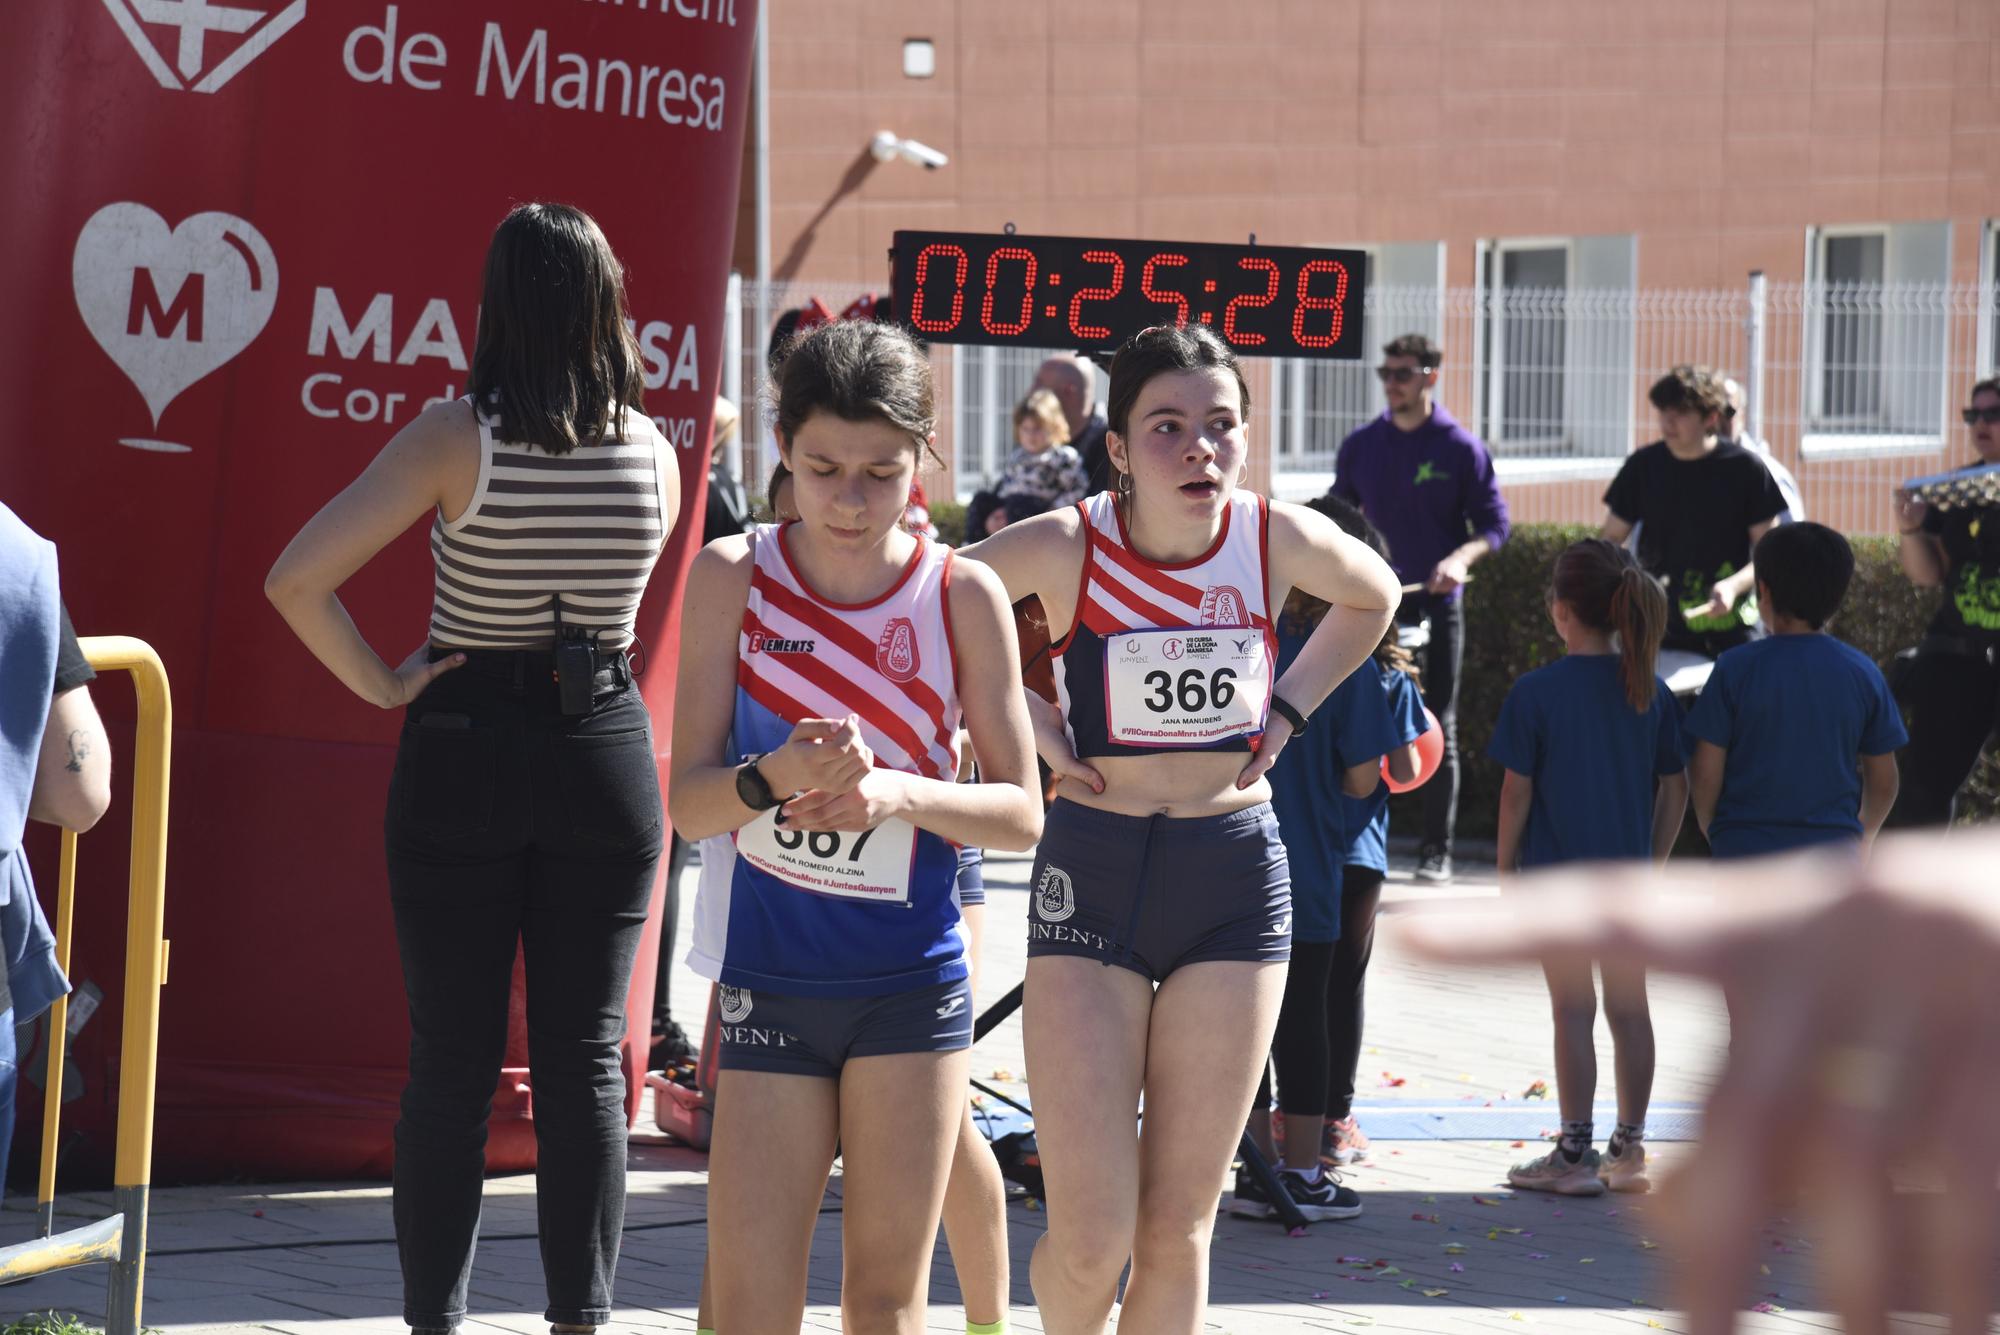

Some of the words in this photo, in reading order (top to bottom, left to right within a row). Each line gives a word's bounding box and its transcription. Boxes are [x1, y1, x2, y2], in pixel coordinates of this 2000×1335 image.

[343, 4, 447, 90] de
[475, 21, 725, 131] Manresa
[126, 266, 205, 343] M
[307, 286, 699, 391] MASA
[301, 372, 406, 424] Cor
[749, 631, 815, 654] ELEMENTS
[1143, 667, 1238, 713] 366
[1160, 717, 1181, 725] JANA
[1182, 715, 1222, 725] MANUBENS
[777, 852, 797, 866] JANA
[798, 859, 835, 874] ROMERO
[835, 867, 865, 877] ALZINA
